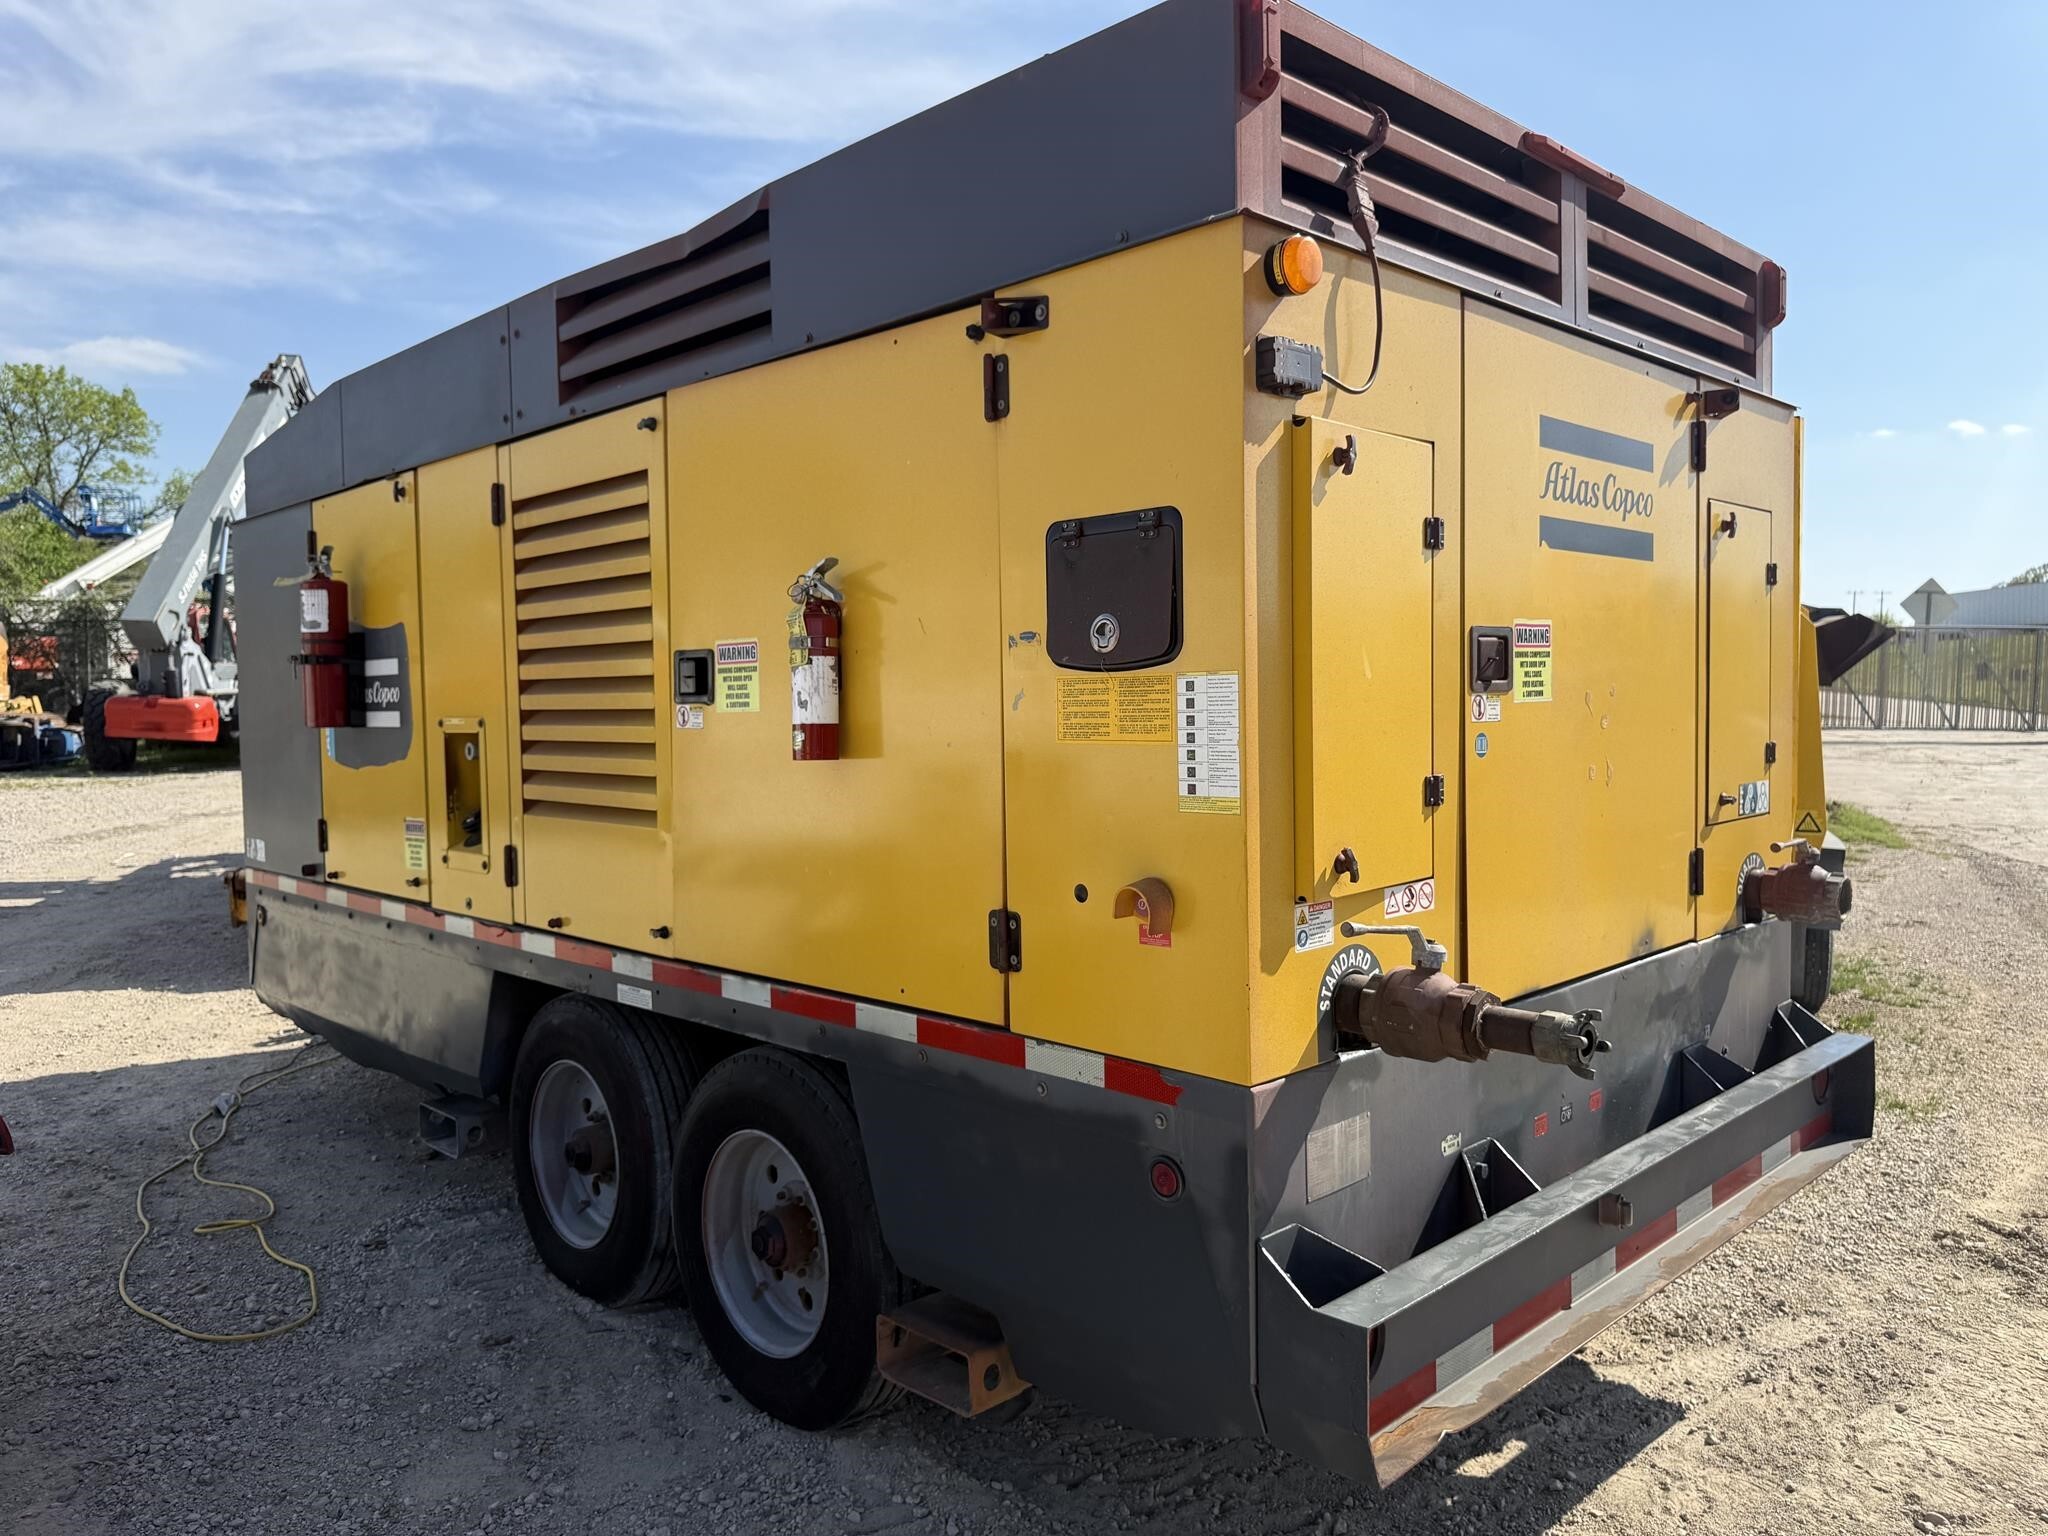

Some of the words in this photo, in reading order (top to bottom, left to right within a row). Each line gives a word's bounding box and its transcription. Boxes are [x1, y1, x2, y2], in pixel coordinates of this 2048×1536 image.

[1539, 461, 1600, 508] Atlas
[1602, 473, 1654, 521] Copco
[1516, 628, 1549, 643] WARNING
[719, 645, 756, 661] WARNING
[373, 681, 400, 708] Copco
[1320, 949, 1371, 1011] STANDARD
